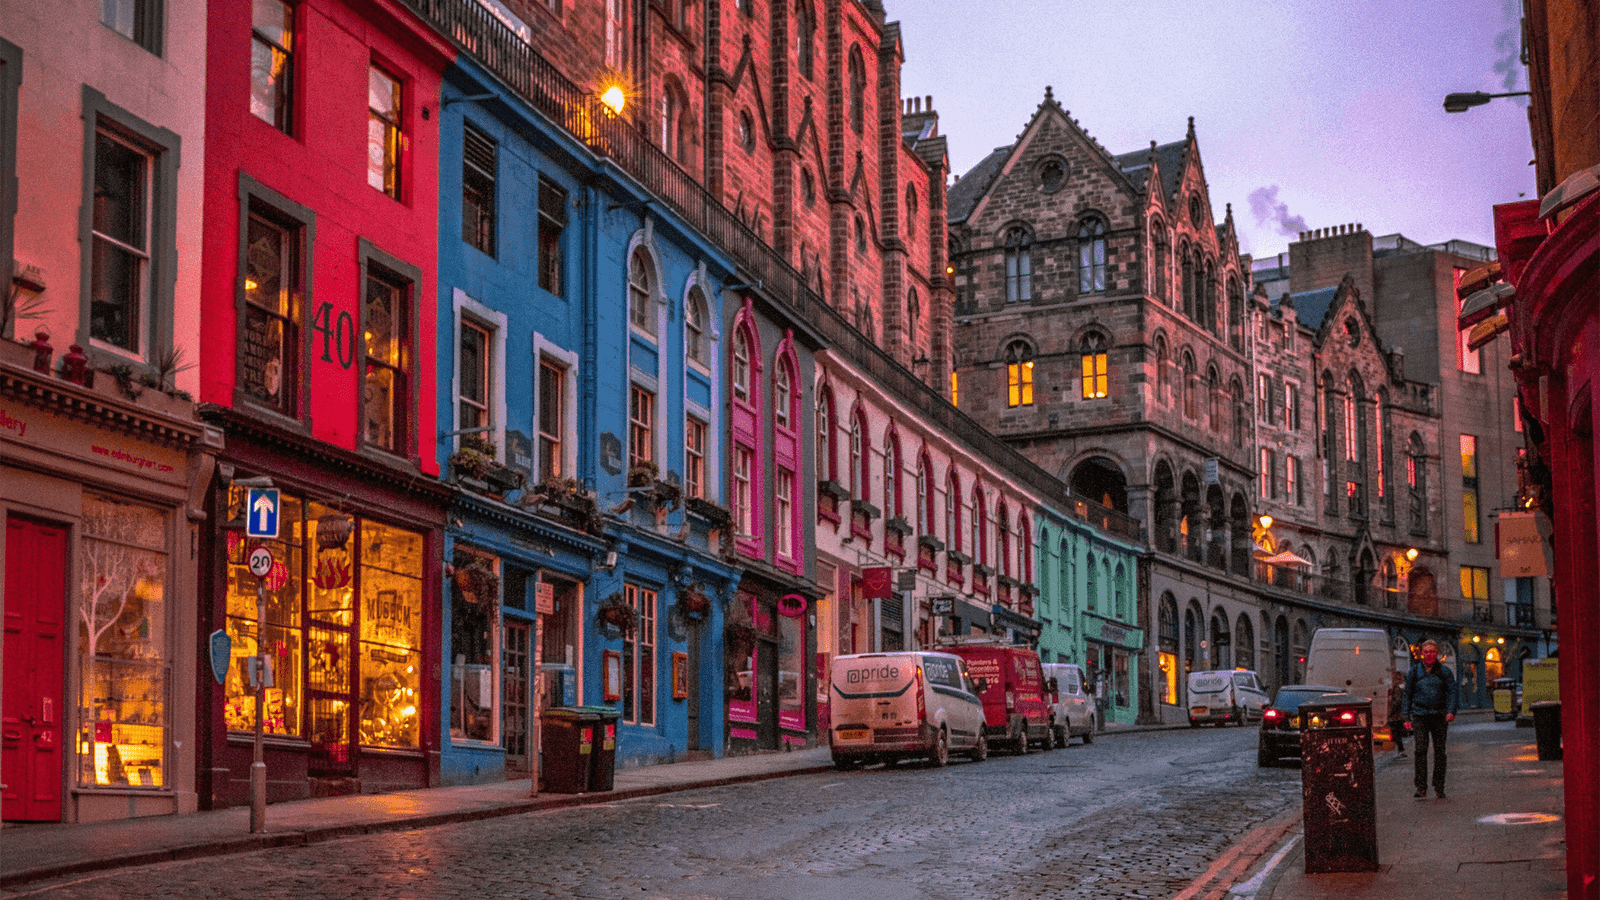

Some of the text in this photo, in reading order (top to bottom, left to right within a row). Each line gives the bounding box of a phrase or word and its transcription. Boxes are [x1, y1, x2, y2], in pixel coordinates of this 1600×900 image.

[312, 301, 354, 370] 40
[251, 555, 270, 569] 20
[40, 731, 52, 742] 42
